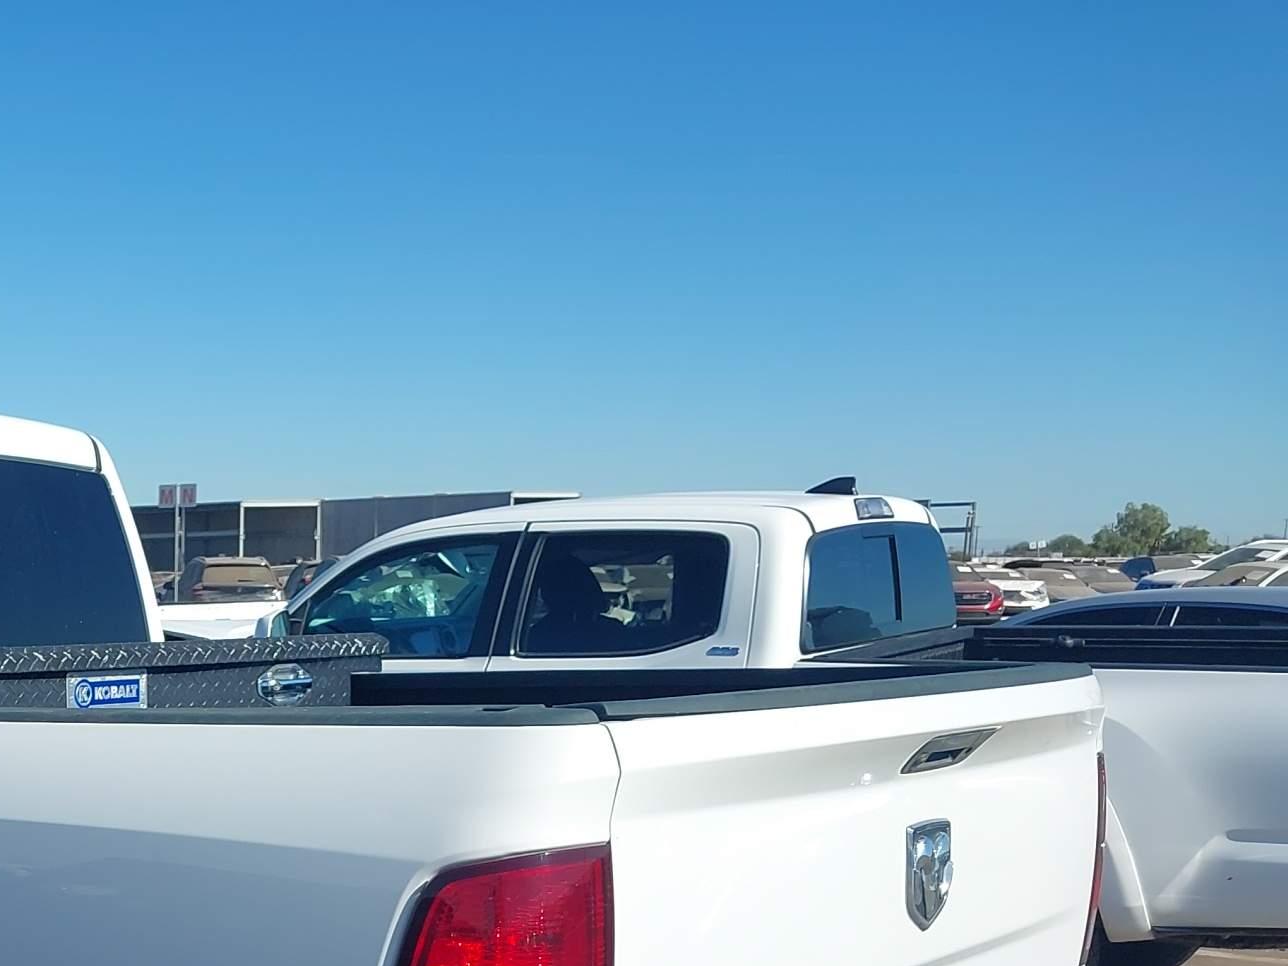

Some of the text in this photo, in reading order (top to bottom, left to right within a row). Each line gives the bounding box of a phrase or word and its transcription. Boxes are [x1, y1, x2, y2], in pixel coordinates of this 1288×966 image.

[161, 488, 174, 505] M
[182, 487, 194, 503] N
[94, 684, 139, 700] KOBALT
